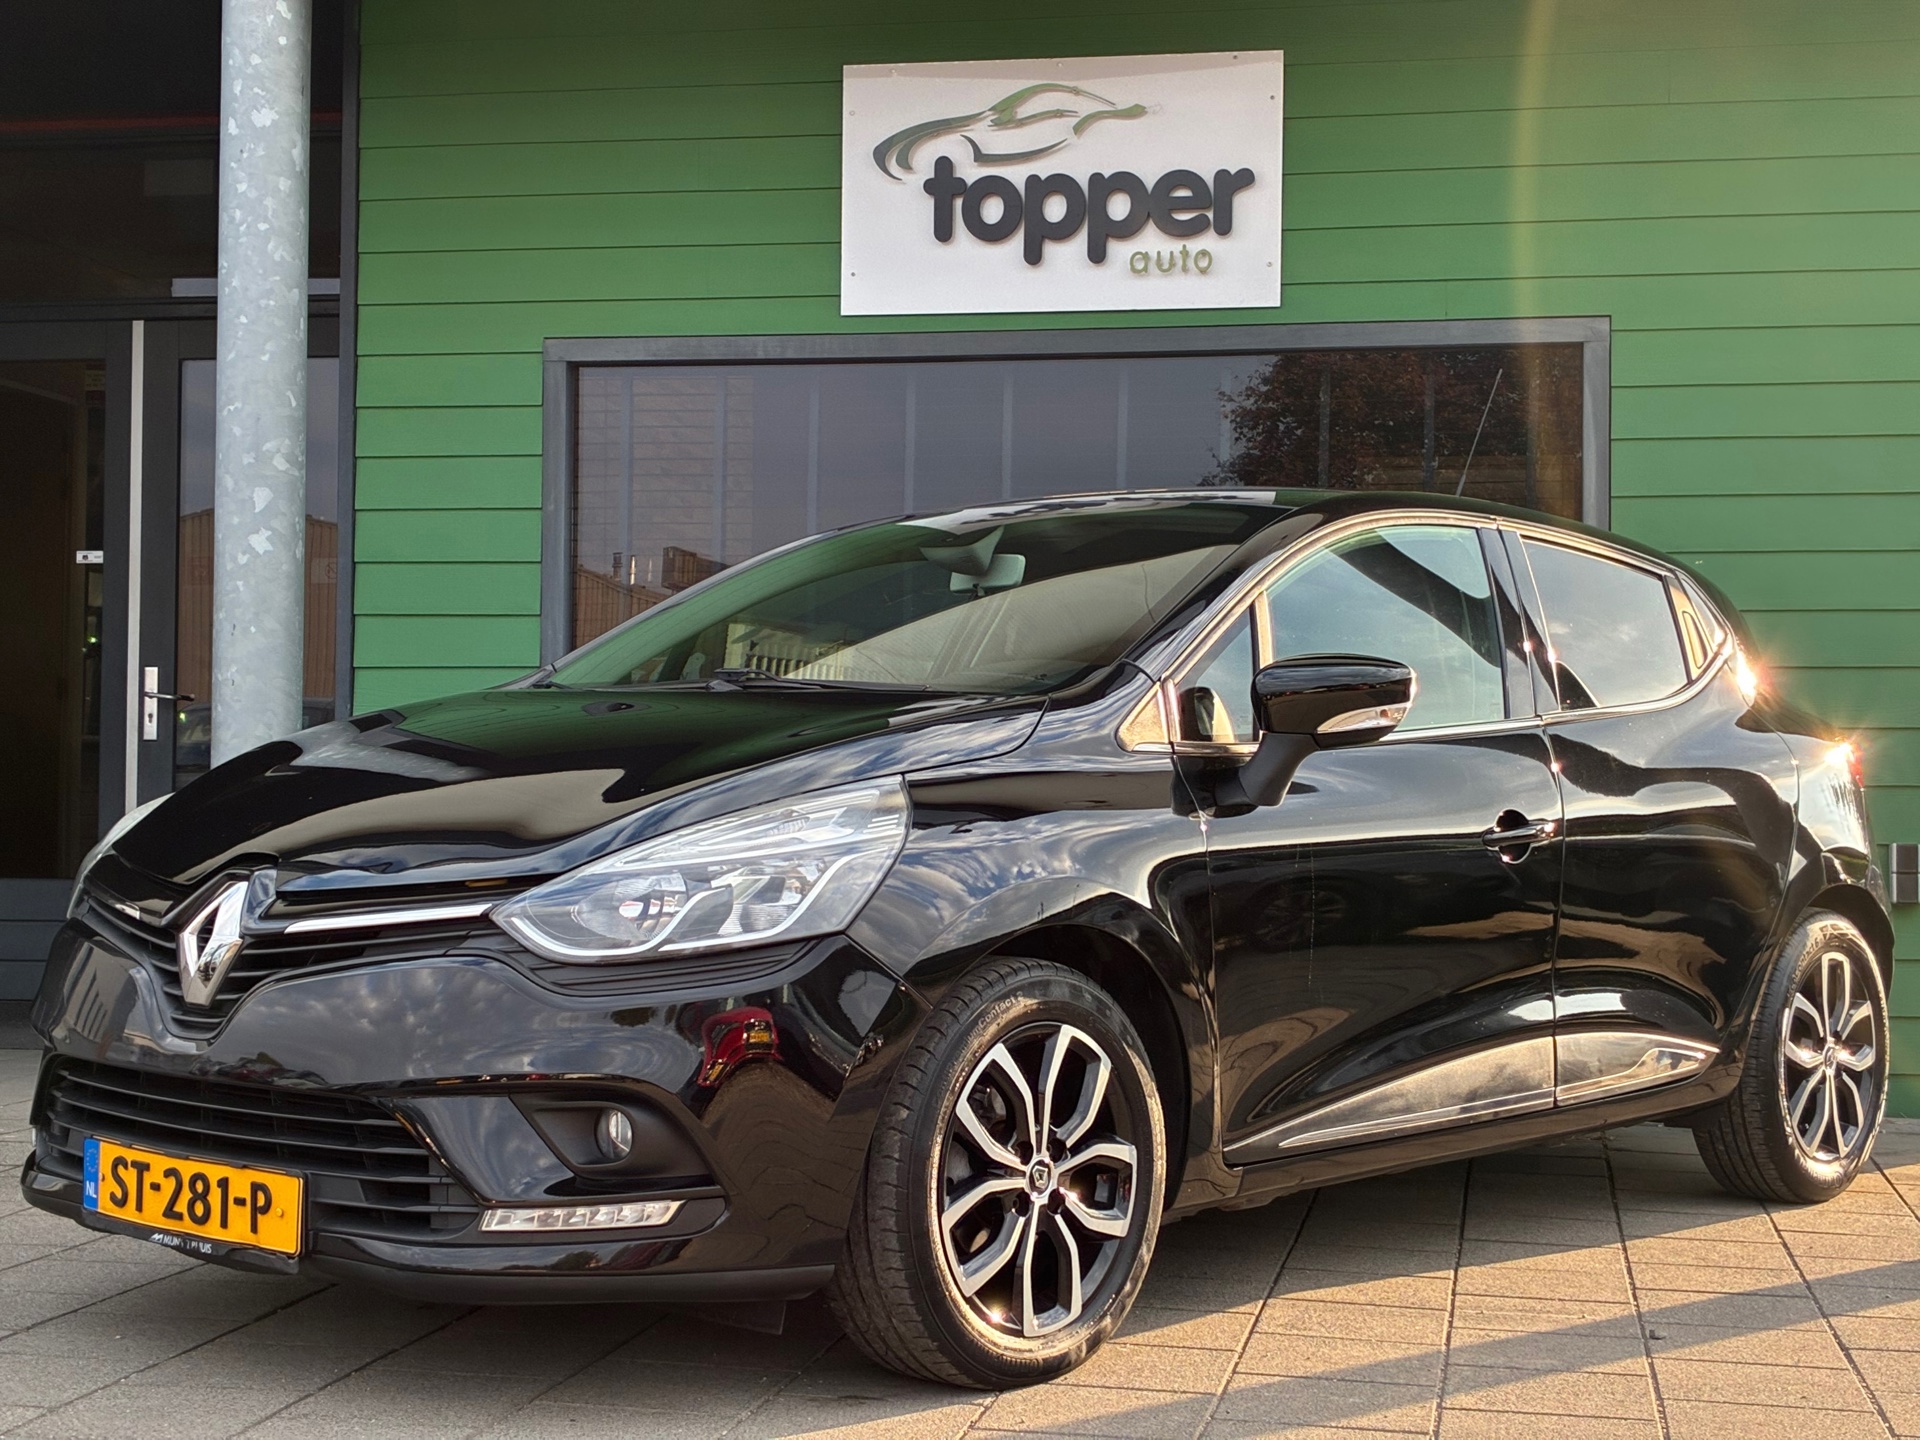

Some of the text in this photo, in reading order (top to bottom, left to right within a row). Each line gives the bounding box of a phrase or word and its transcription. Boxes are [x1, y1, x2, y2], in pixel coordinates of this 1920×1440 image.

[923, 156, 1255, 265] topper
[1130, 244, 1213, 274] auto
[86, 1180, 97, 1198] NL
[110, 1155, 272, 1234] ST-281-P
